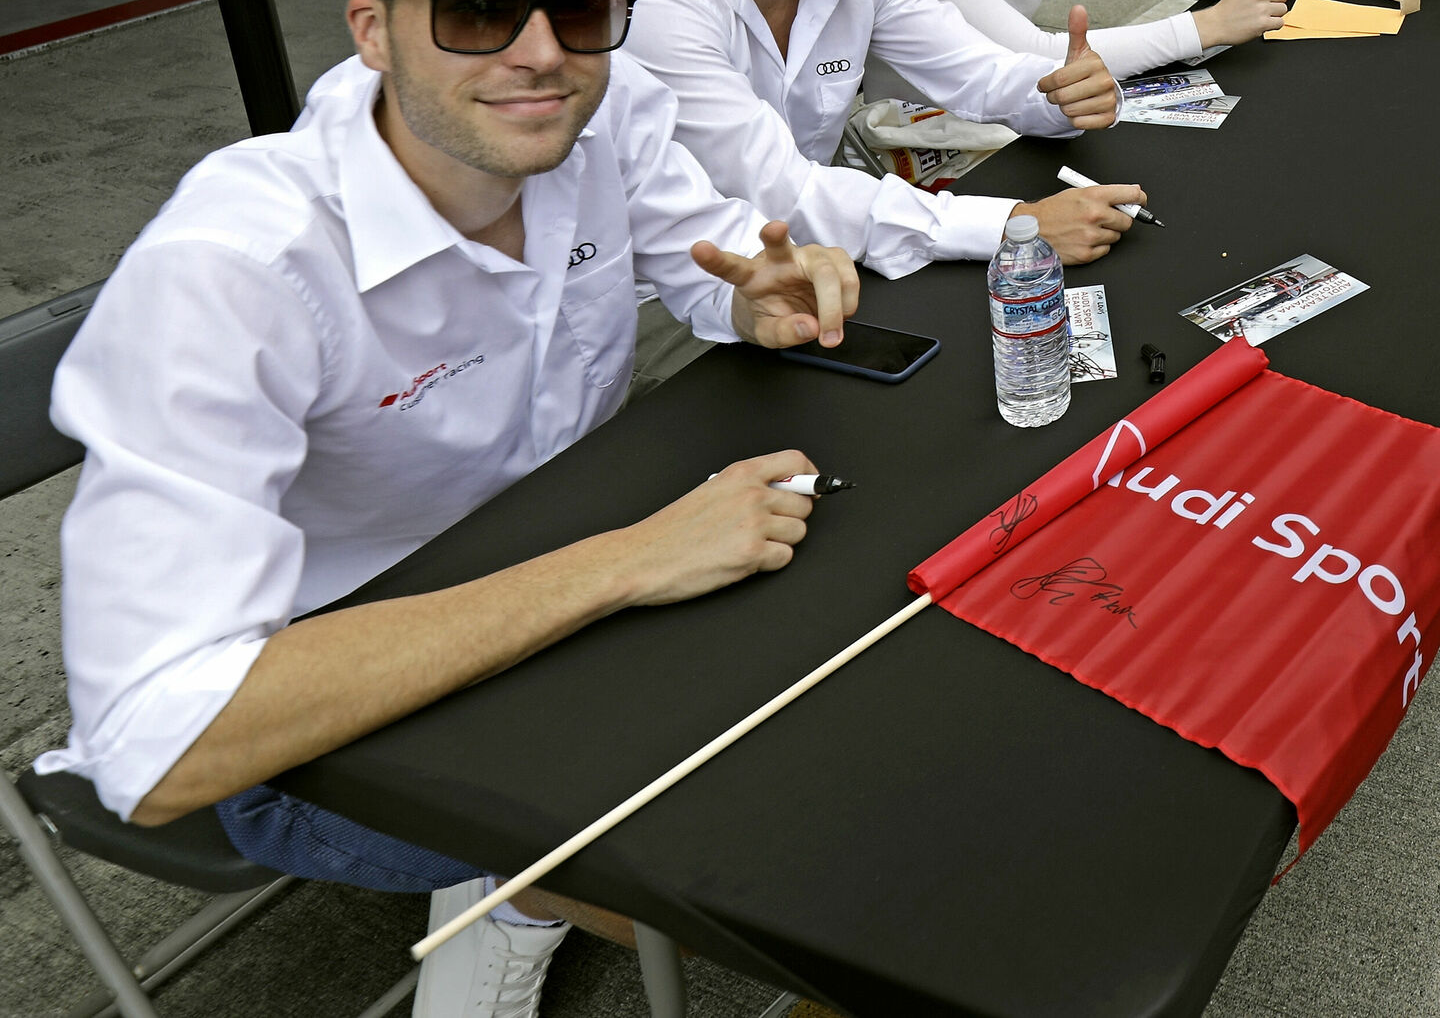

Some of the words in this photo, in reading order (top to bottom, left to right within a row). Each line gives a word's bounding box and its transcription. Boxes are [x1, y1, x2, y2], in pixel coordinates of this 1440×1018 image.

[1003, 304, 1039, 315] CRYSTAL
[1071, 292, 1081, 311] TEAM
[1074, 312, 1083, 328] WRT
[1084, 309, 1094, 330] SPORT
[444, 355, 485, 380] racing
[1251, 512, 1424, 709] Sport
